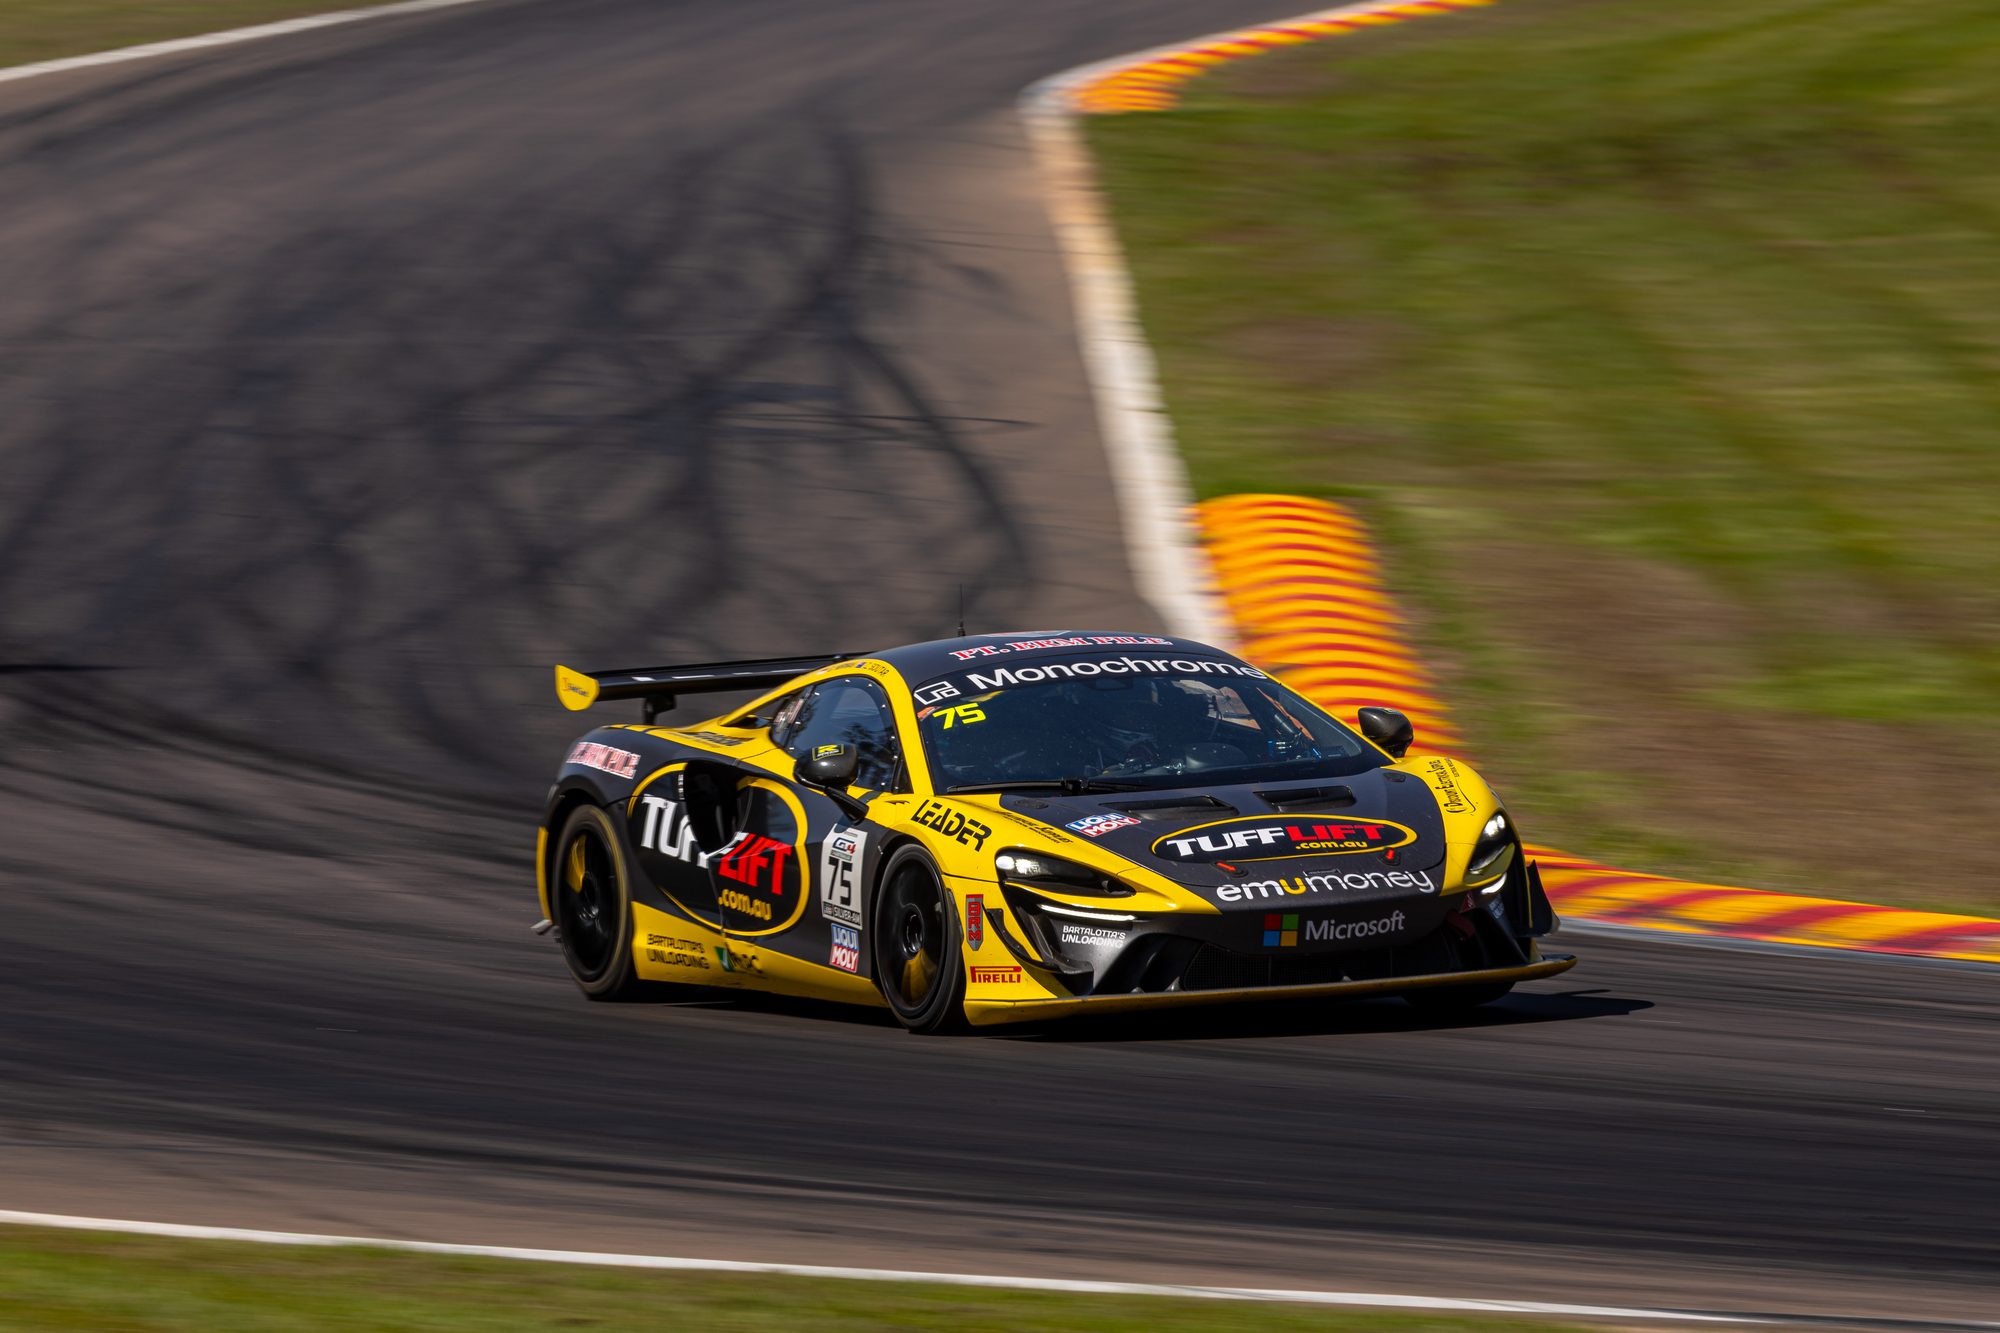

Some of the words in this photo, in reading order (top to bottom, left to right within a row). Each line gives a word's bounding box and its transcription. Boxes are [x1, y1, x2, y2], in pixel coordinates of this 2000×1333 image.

[949, 645, 1010, 661] PT.
[1011, 637, 1088, 651] BRM
[1091, 636, 1173, 646] PILE
[966, 656, 1268, 690] Monochrome
[932, 702, 987, 730] 75
[910, 799, 993, 853] LEADER
[1070, 812, 1126, 831] LIQUI
[1085, 816, 1137, 837] MOLY
[1295, 839, 1368, 850] .com.au
[828, 855, 853, 907] 75
[1216, 869, 1436, 902] emumoney
[718, 888, 772, 921] .com.au
[832, 925, 859, 950] LIQUI
[1062, 925, 1126, 940] BARTALOTTA'S
[1305, 910, 1405, 941] Microsoft
[1061, 934, 1124, 948] UNLOADING
[831, 945, 859, 971] MOLY
[970, 965, 1022, 983] PIRELLI
